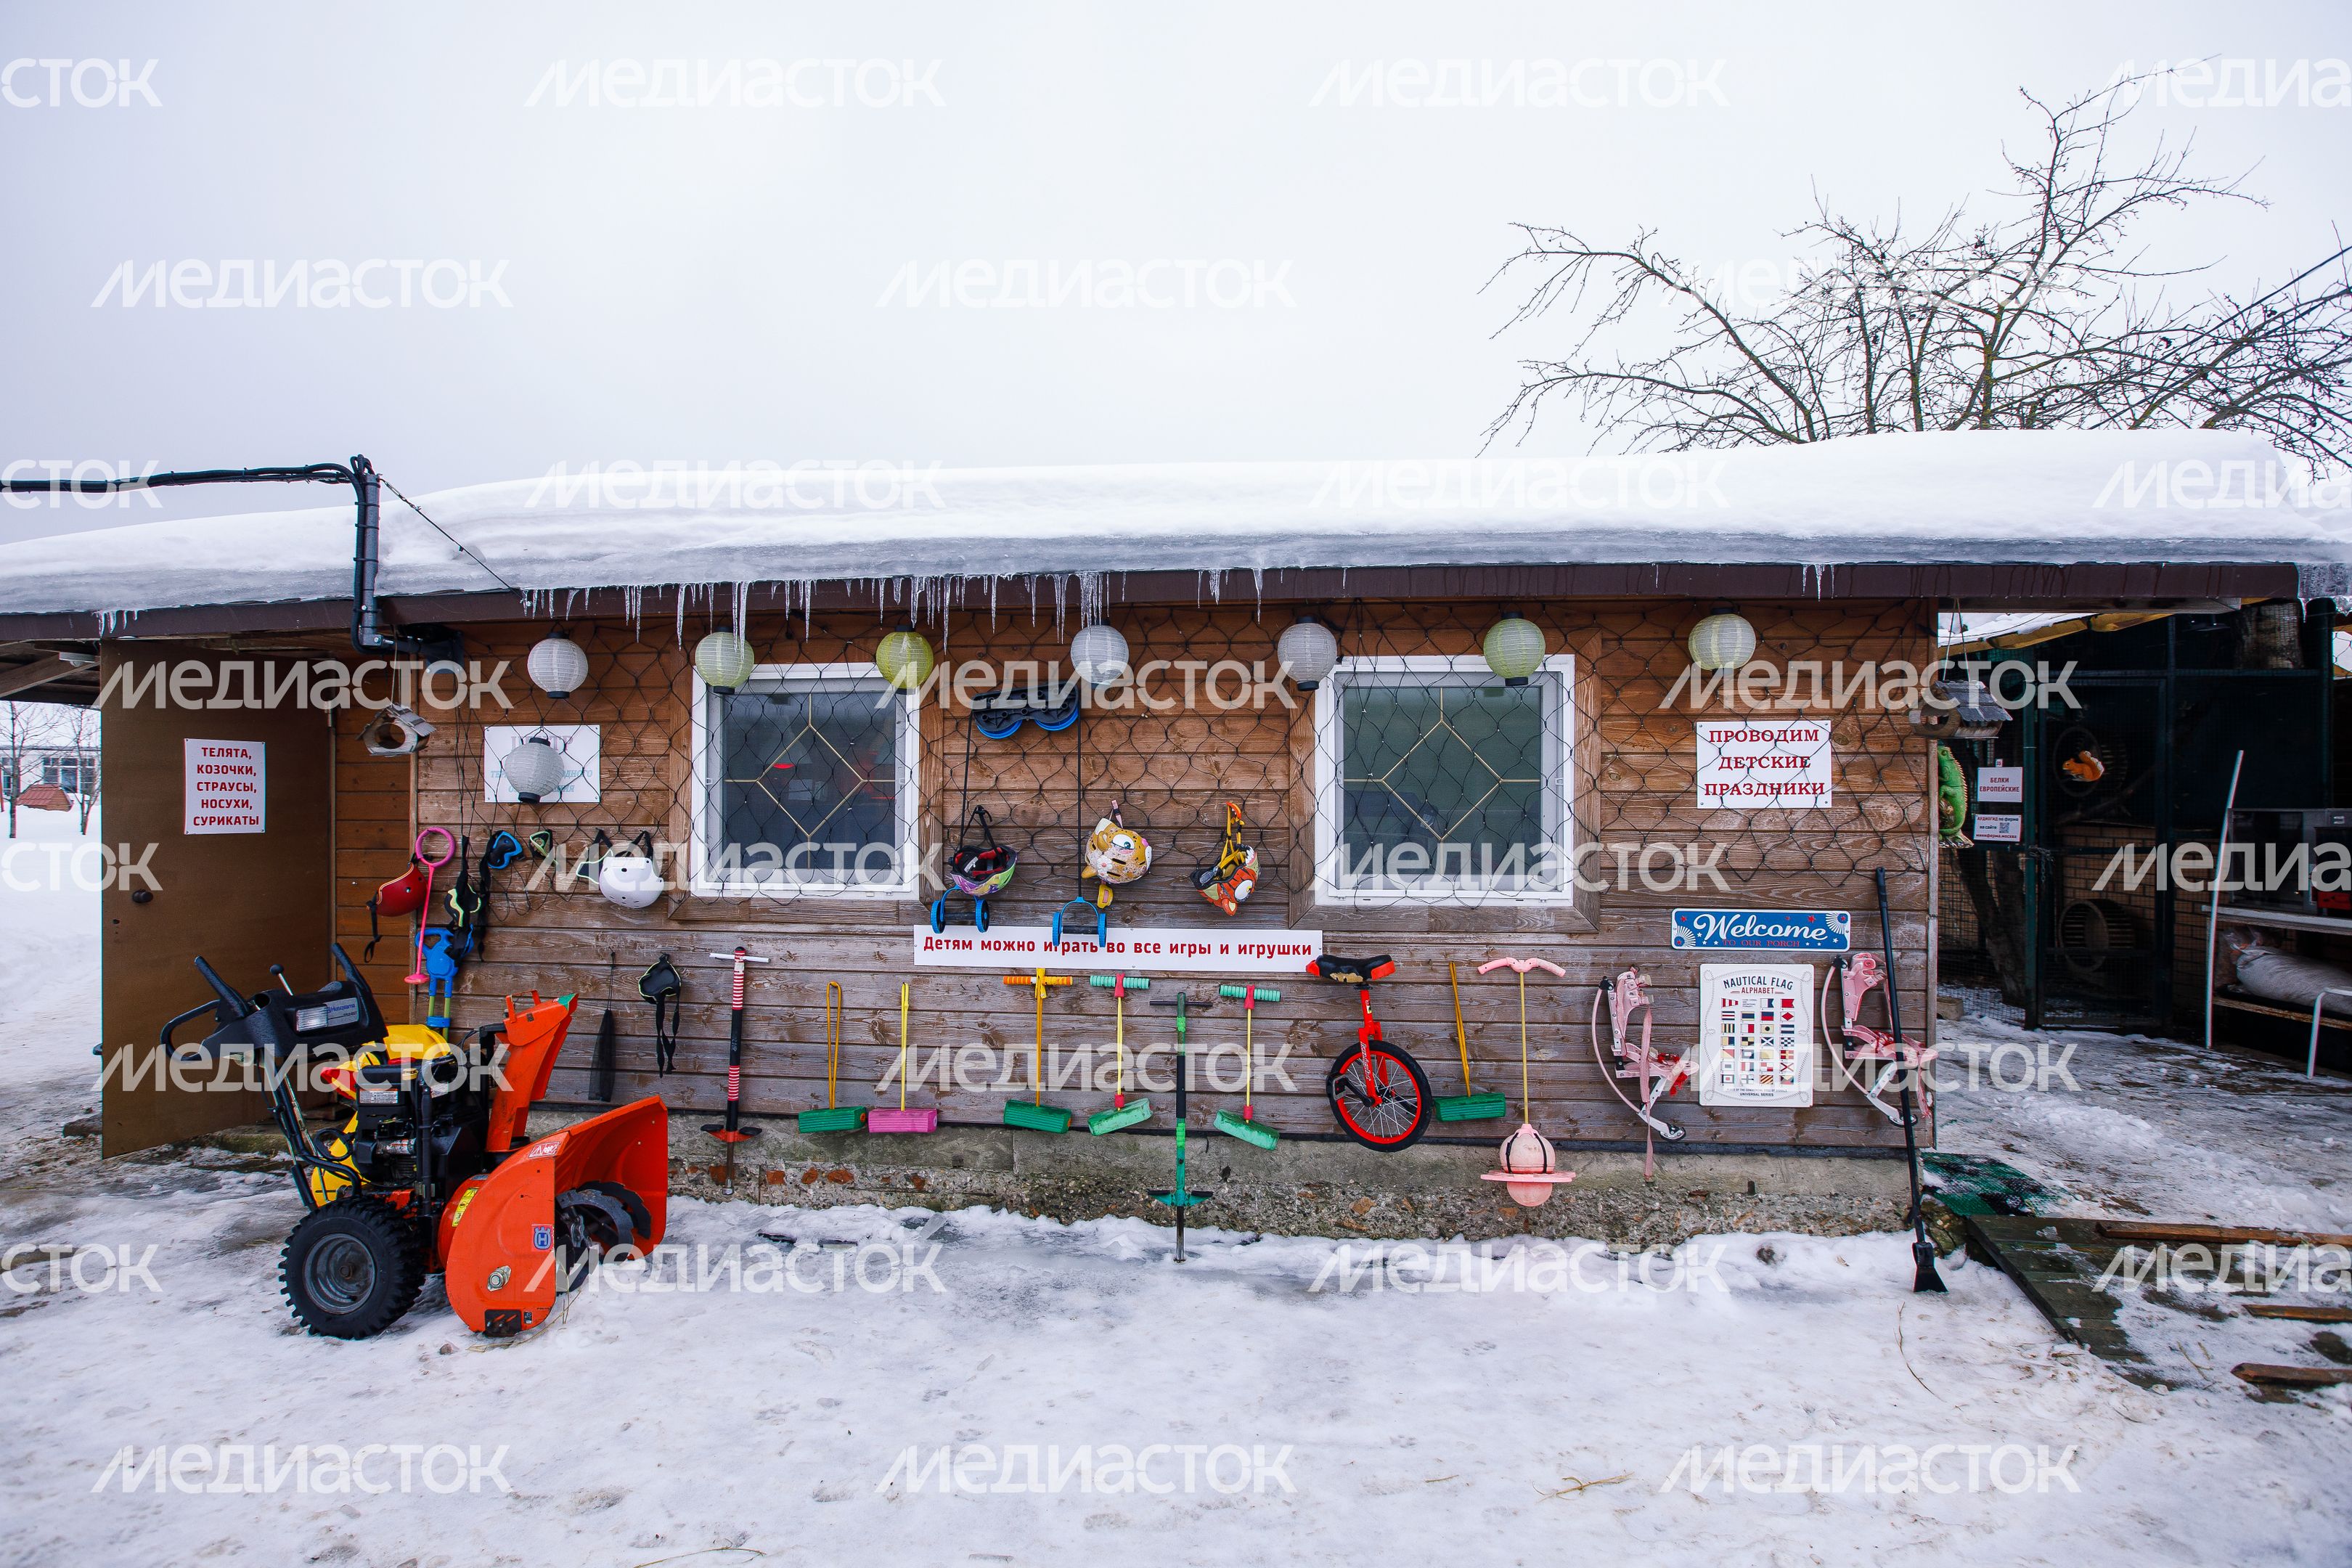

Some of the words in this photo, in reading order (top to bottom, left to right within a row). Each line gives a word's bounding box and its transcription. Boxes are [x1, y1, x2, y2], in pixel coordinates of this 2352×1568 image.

[1709, 730, 1819, 744] ПРОВОДИМ
[201, 747, 252, 760] ТЕЛЯТА,
[1718, 756, 1811, 770] ДЕТСКИЕ
[197, 764, 257, 777] КОЗОЧКИ,
[197, 782, 257, 793] СТРАУСЫ,
[1704, 783, 1825, 797] ПРАЗДНИКИ
[201, 799, 253, 810] НОСУХИ,
[193, 816, 259, 825] СУРИКАТЫ
[1693, 914, 1829, 941] Welcome
[923, 936, 973, 952] Детям
[981, 940, 1035, 952] можно
[1106, 942, 1125, 953] во
[1134, 942, 1161, 954] все
[1169, 943, 1212, 957] игры
[1220, 944, 1229, 955] и
[1238, 944, 1312, 959] игрушки
[1723, 976, 1767, 989] NAUTICAL
[1771, 977, 1794, 990] FLAG
